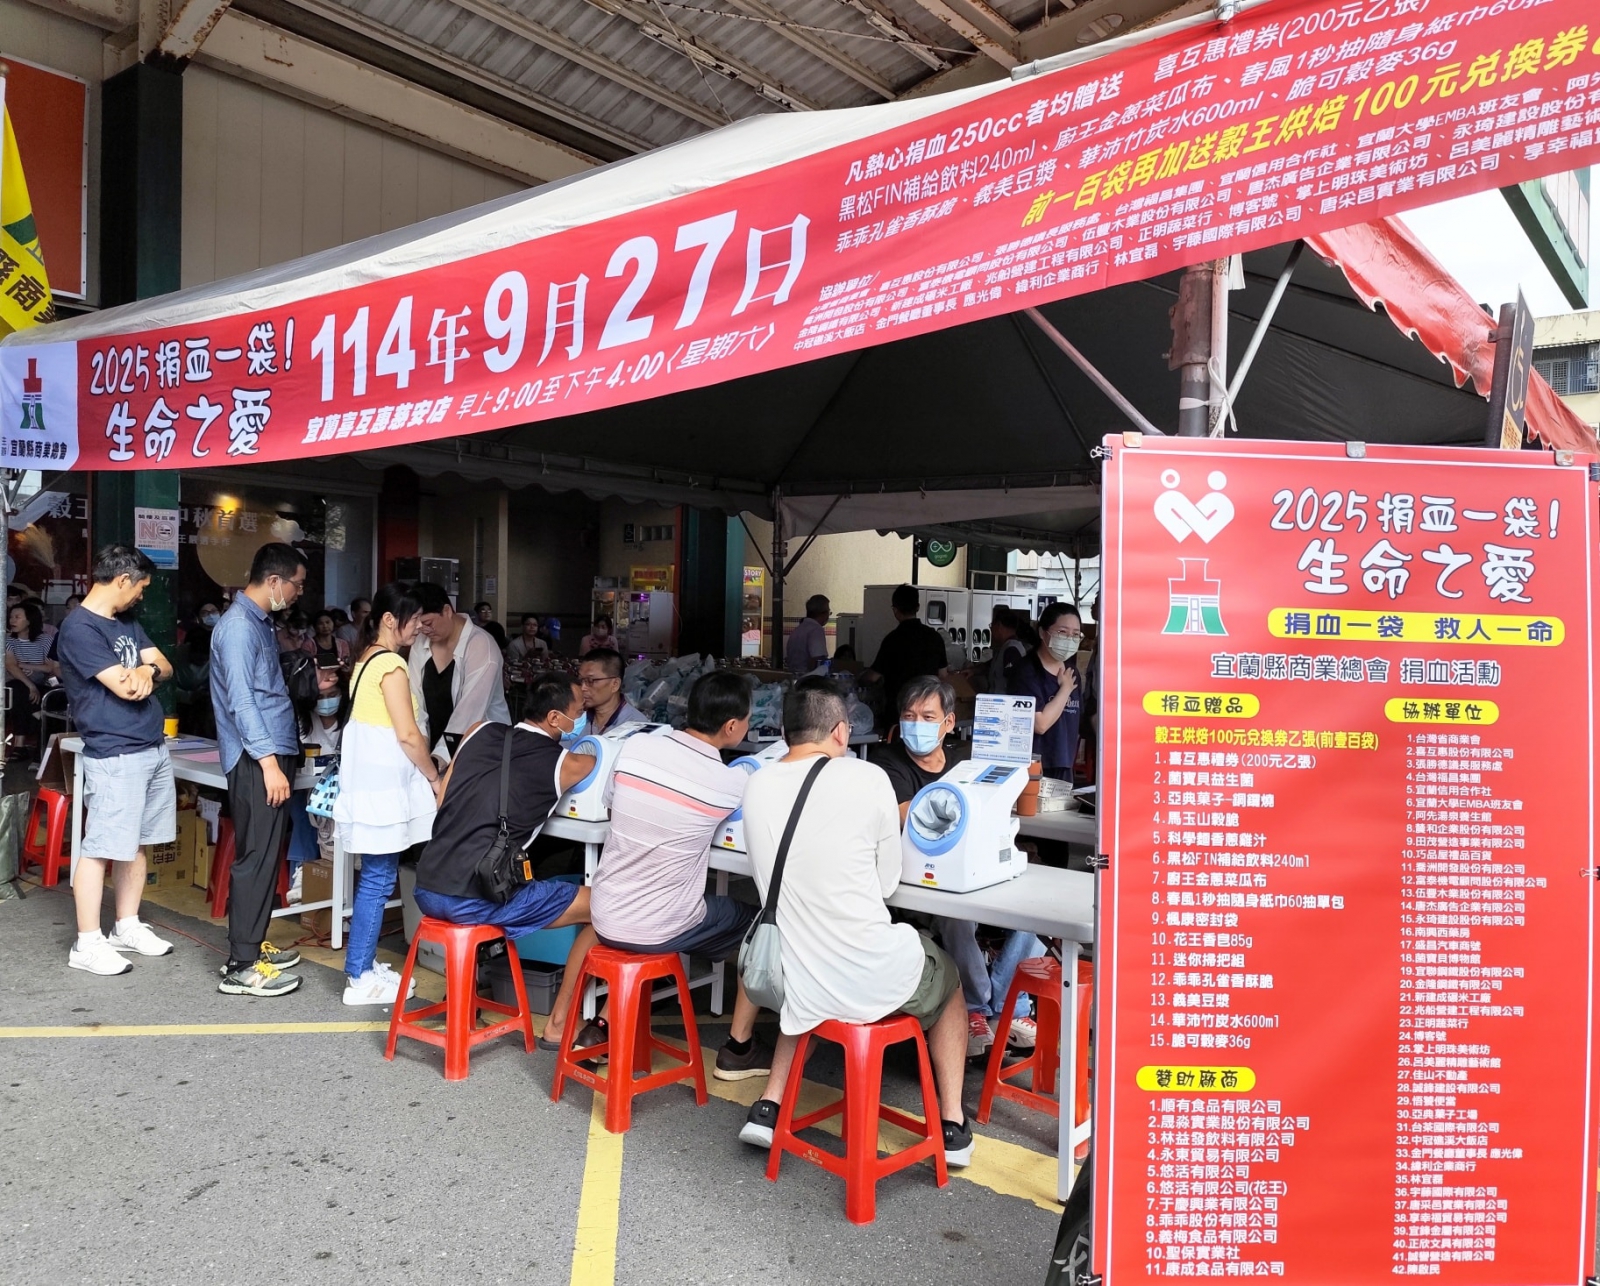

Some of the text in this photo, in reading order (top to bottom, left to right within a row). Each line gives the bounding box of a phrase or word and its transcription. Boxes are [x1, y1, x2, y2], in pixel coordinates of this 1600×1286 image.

[1022, 24, 1600, 227] 前一百袋再加送穀王烘焙100元兌換券
[310, 209, 811, 402] 114年9月27日
[105, 388, 272, 463] 生命之愛
[302, 395, 453, 445] 宜蘭喜互惠慈安店
[1298, 538, 1536, 604] 生命之愛
[1284, 612, 1553, 643] 捐血一袋 救人一命
[1211, 653, 1390, 684] 宜蘭縣商業總會
[1162, 695, 1243, 713] 捐血贈品
[1403, 702, 1482, 720] 協辦單位
